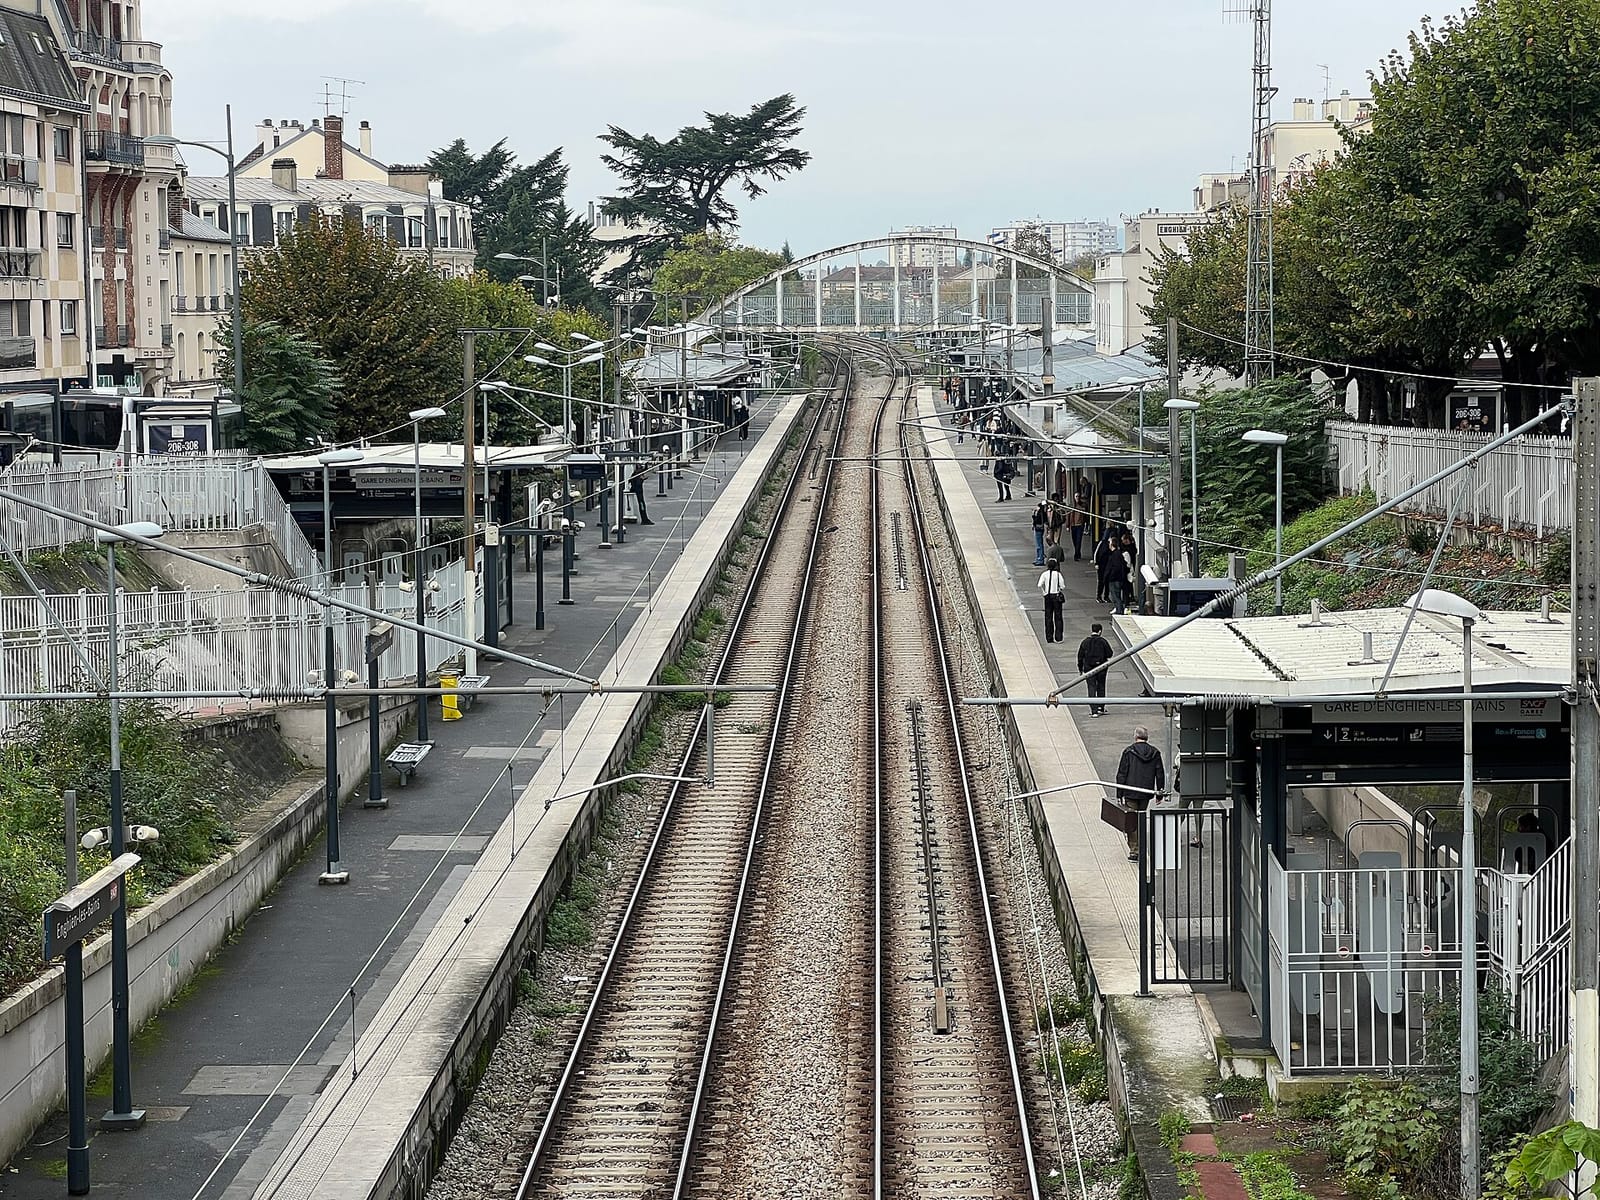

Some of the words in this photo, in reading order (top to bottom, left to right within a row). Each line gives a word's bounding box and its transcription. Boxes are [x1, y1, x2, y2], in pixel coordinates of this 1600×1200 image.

[1323, 700, 1359, 712] GARE
[1521, 699, 1545, 708] SNCF
[1342, 731, 1349, 740] 2
